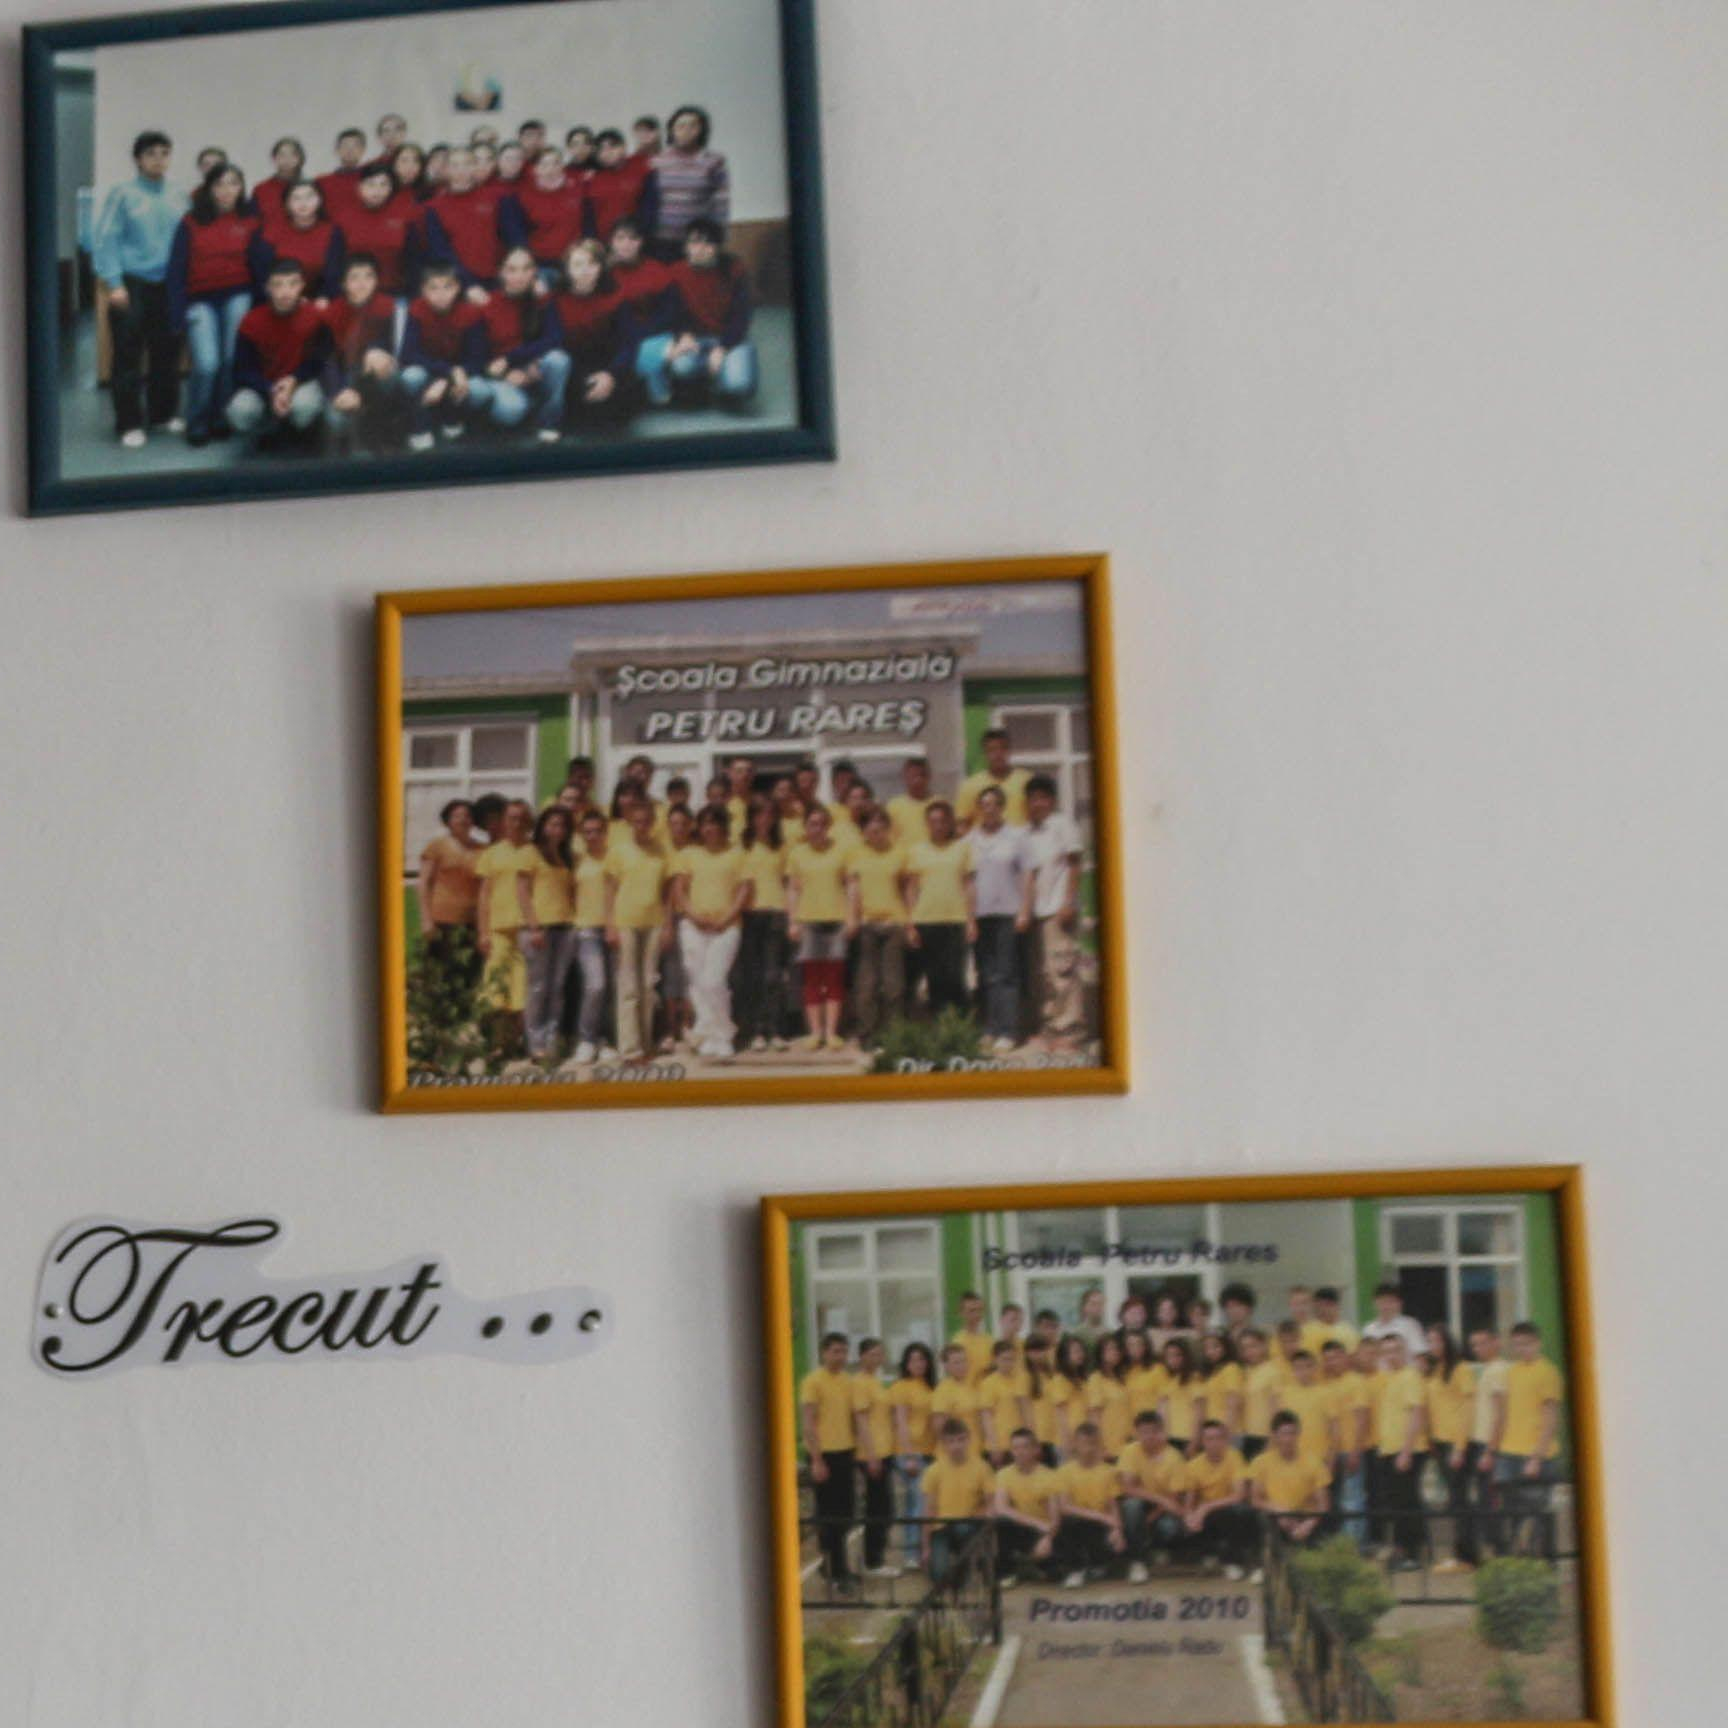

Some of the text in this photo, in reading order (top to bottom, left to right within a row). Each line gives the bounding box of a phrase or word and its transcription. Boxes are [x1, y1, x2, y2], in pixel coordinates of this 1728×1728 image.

[647, 707, 775, 742] PETRU
[43, 1219, 442, 1371] Trecut
[1178, 1595, 1251, 1620] 2010
